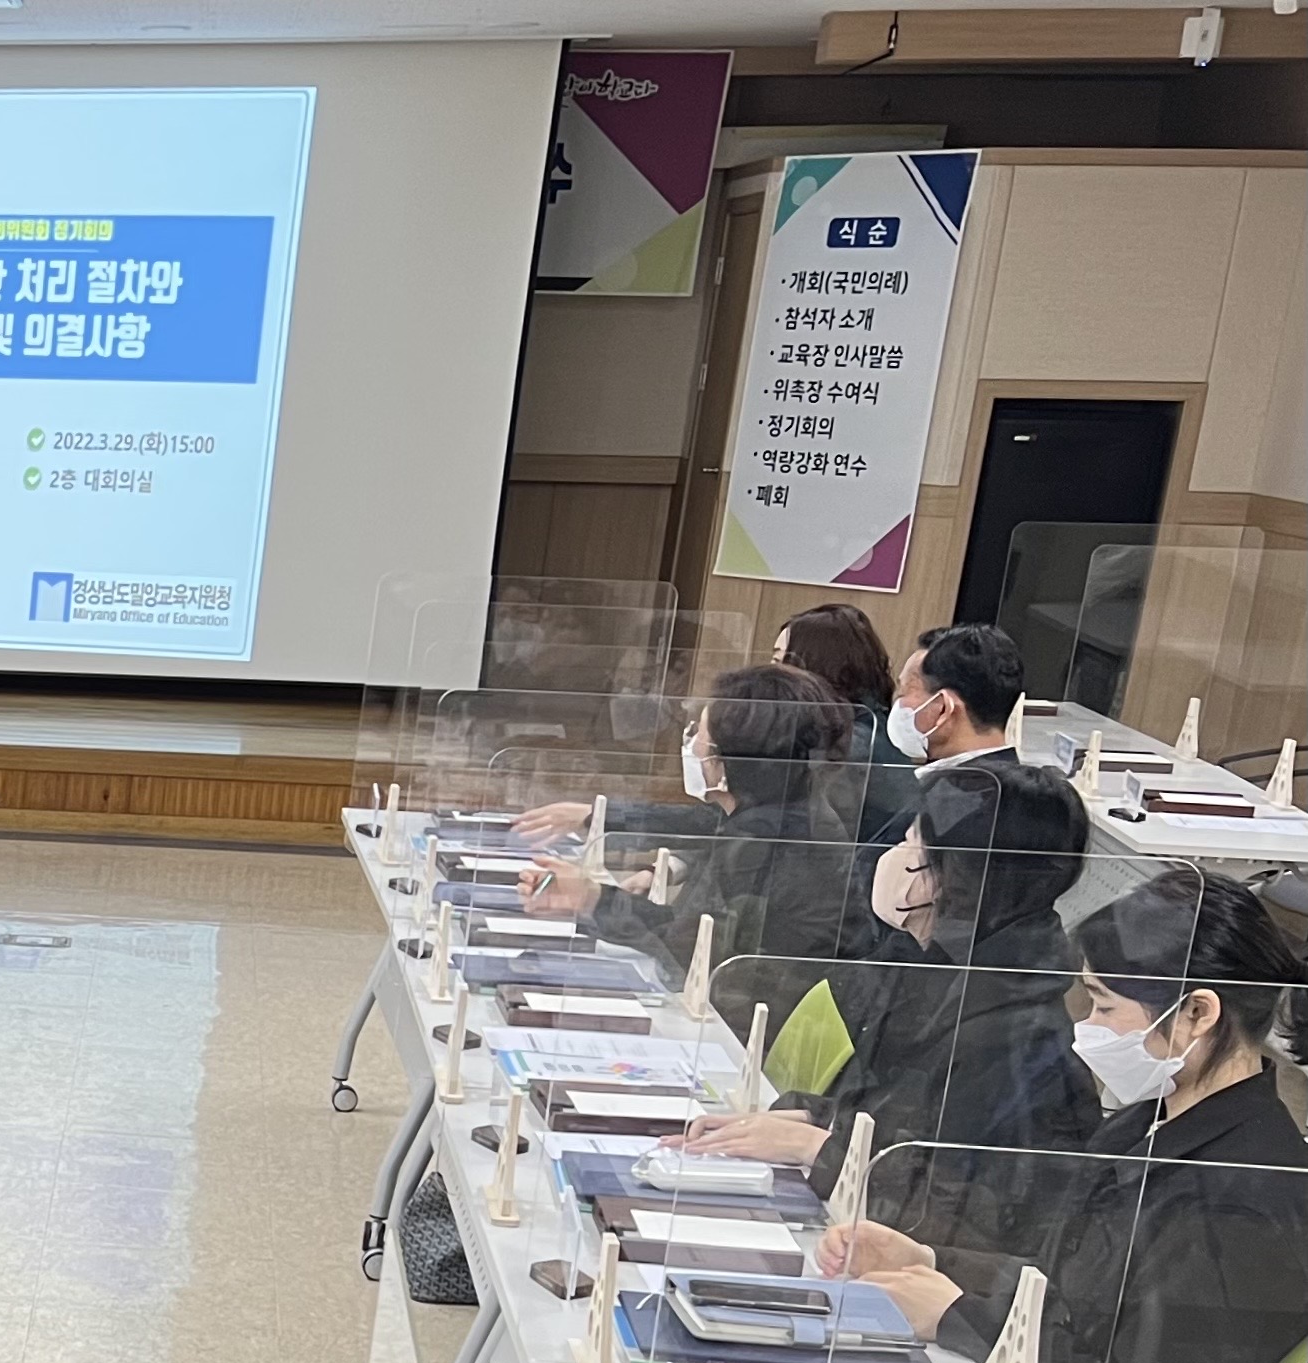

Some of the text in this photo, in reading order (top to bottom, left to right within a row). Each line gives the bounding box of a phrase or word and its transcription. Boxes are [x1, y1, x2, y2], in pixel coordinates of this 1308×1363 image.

[15, 257, 77, 303] 처리
[87, 258, 183, 305] 절차와
[789, 270, 908, 295] 개회(국민의례)
[784, 307, 874, 332] 참석자 소개
[23, 312, 151, 359] 의결사항
[777, 343, 904, 370] 교육장 인사말씀
[773, 379, 879, 405] 위촉장 수여식
[768, 415, 834, 439] 정기회의
[762, 449, 867, 477] 역량강화 연수
[49, 469, 153, 493] 2층 대회의실
[756, 485, 789, 508] 폐회
[72, 579, 232, 611] 경상남도밀양교육지원청
[73, 608, 229, 627] Miryang Office of Education
